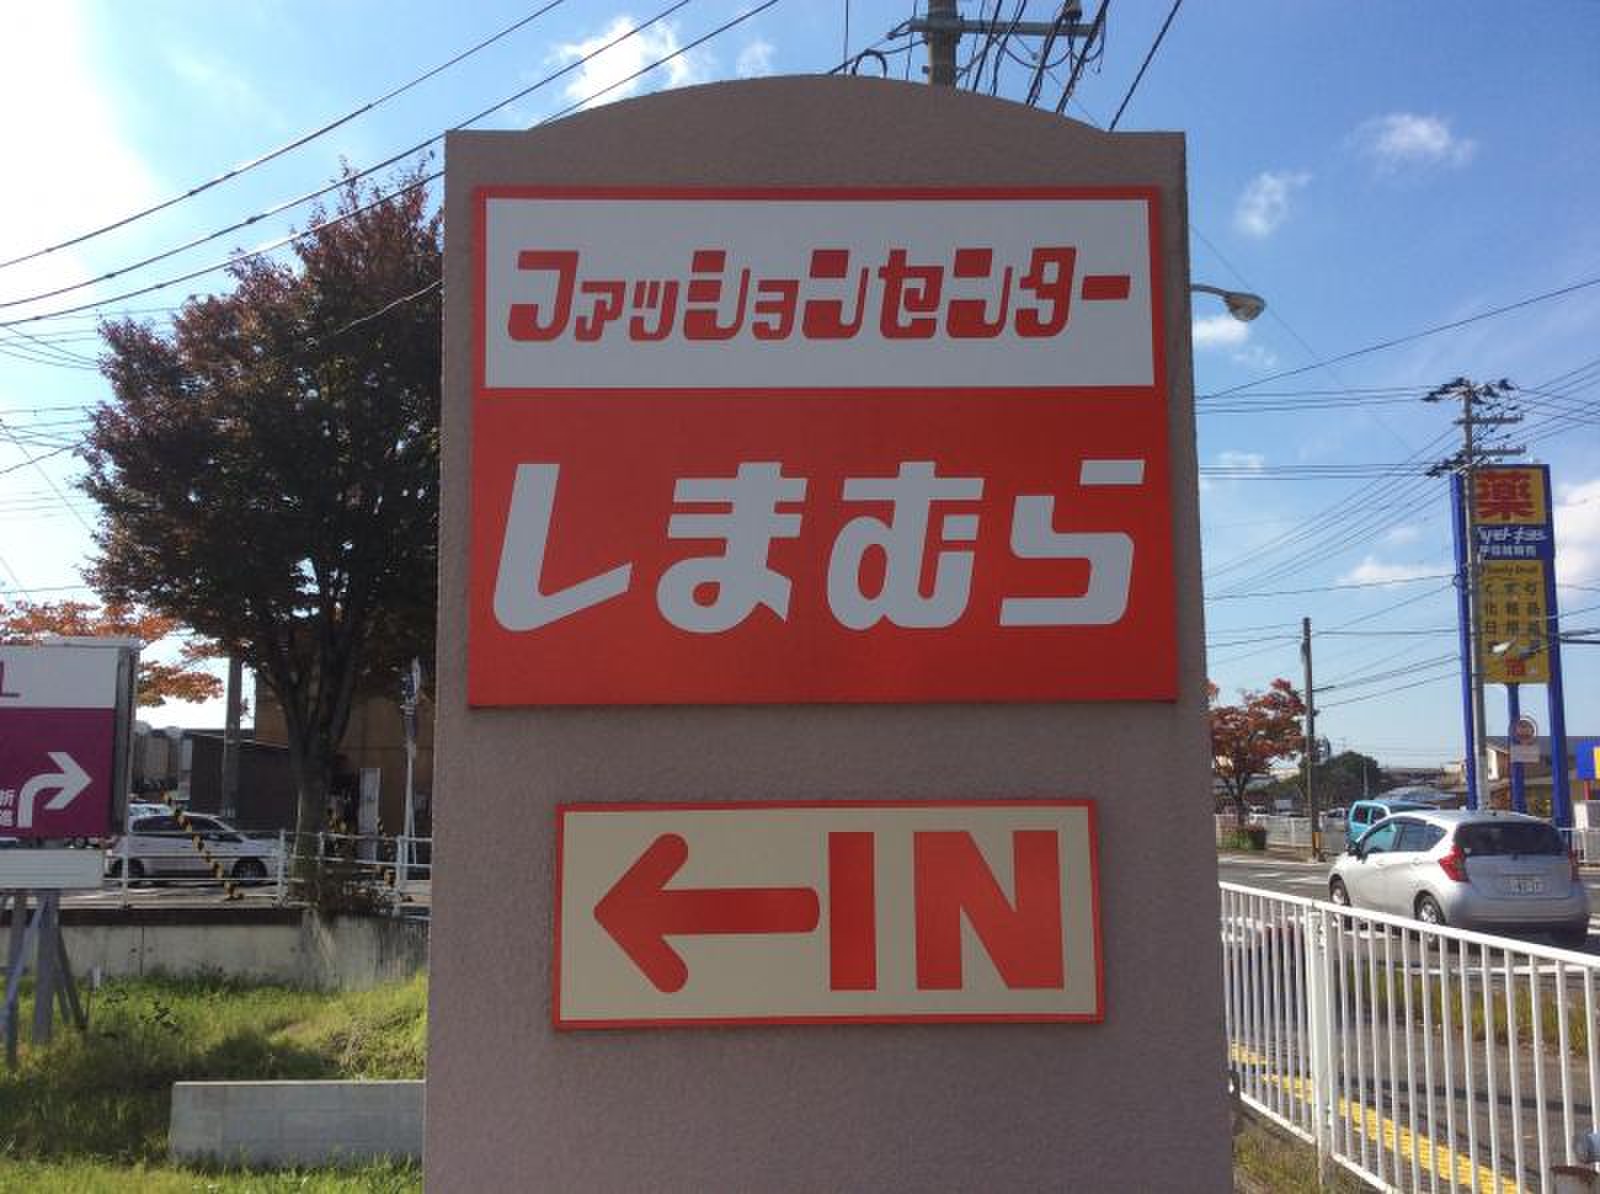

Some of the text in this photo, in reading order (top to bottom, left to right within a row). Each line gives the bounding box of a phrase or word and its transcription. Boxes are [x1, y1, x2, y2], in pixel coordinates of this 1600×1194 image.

[507, 247, 1132, 342] ファッションセンター
[493, 459, 1146, 634] しまむら
[828, 830, 1065, 992] IN
